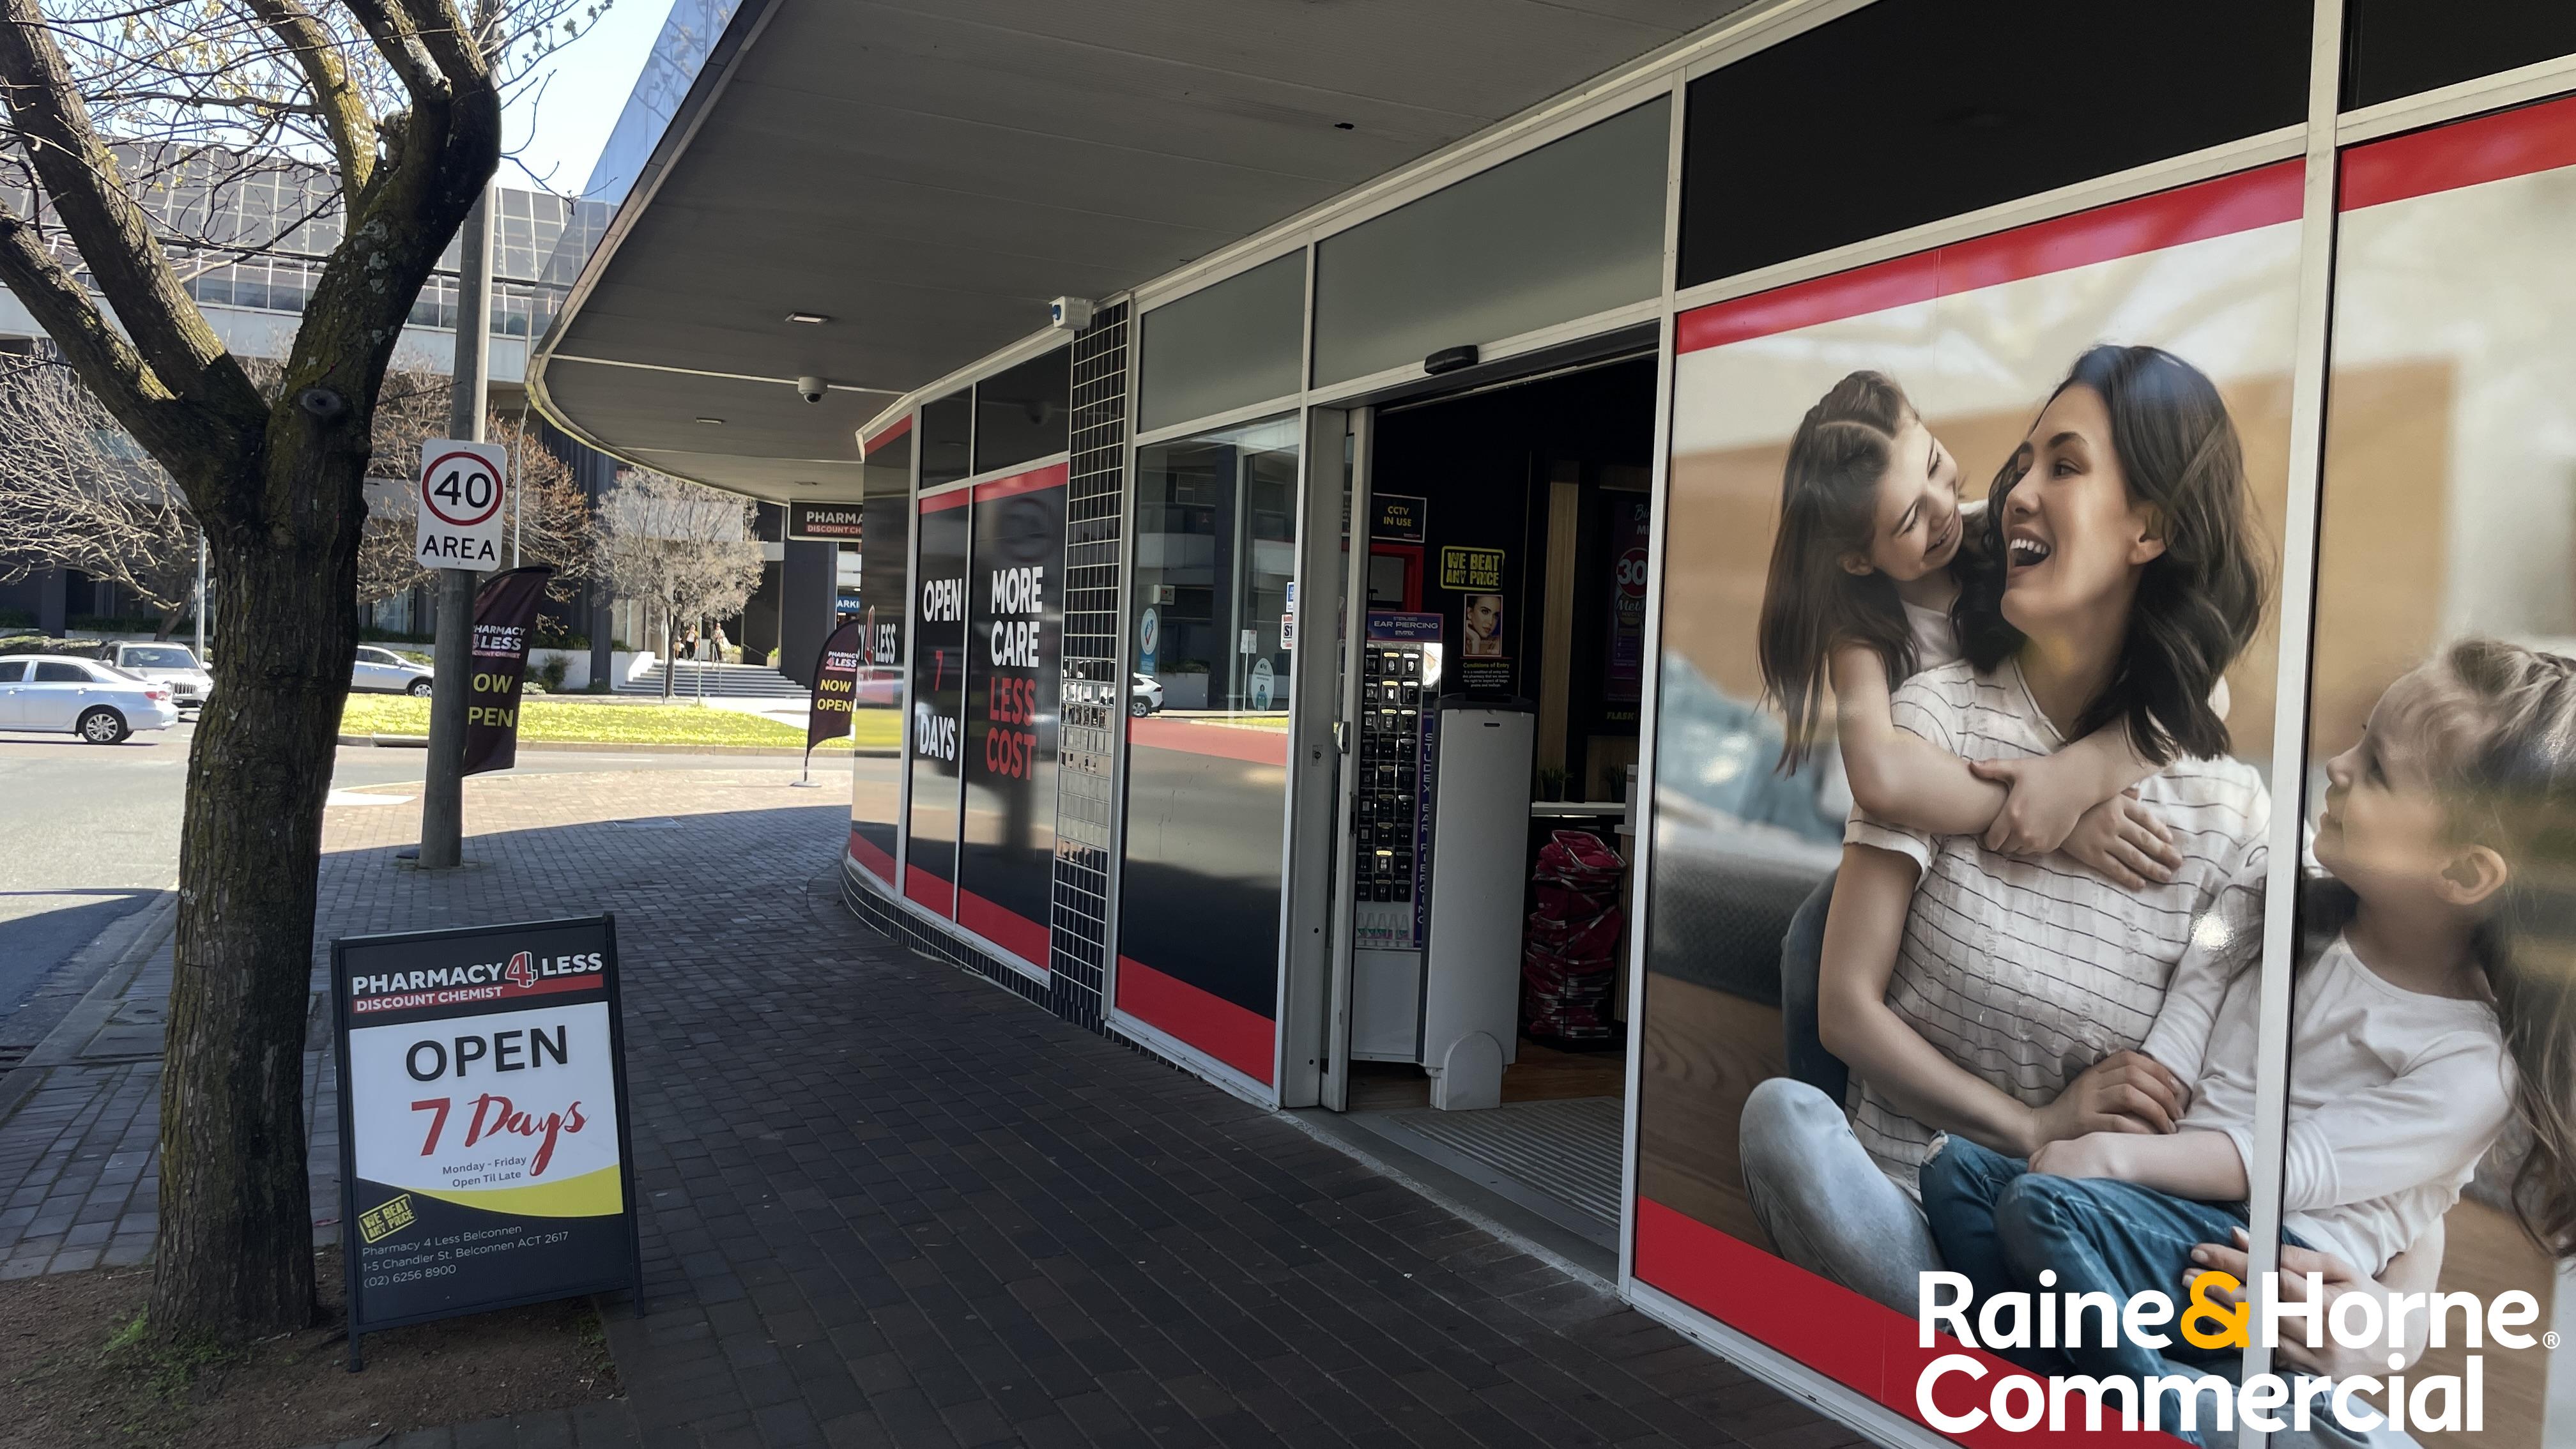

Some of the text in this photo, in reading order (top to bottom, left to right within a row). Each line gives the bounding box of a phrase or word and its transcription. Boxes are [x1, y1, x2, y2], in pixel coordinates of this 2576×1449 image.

[434, 471, 492, 509] 40
[806, 511, 863, 524] PHARMA
[1383, 516, 1411, 526] IN USE
[1388, 505, 1409, 516] CCTV
[808, 525, 848, 533] DISCOUNT
[422, 535, 496, 562] AREA
[1447, 552, 1499, 571] WE BEAT
[1617, 558, 1648, 586] 30
[1446, 569, 1499, 586] ANY PRICE
[924, 579, 962, 622] OPEN
[991, 566, 1043, 615] MORE
[837, 599, 860, 608] ARKI
[473, 625, 526, 636] HARMACY
[480, 636, 521, 650] LESS
[864, 604, 875, 682] 4
[875, 623, 896, 664] LESS
[828, 651, 859, 659] PHARMACY
[991, 620, 1039, 668] CARE
[835, 657, 857, 668] LESS
[935, 650, 944, 691] 7
[473, 673, 512, 694] OW
[820, 679, 852, 693] NOW
[816, 698, 852, 712] OPEN
[990, 677, 1036, 727] LESS
[468, 707, 514, 727] PEN
[919, 714, 956, 761] DAYS
[986, 726, 1036, 780] COST
[352, 951, 602, 995] PHARMACY 4 LESS
[356, 986, 503, 1011] DISCOUNT CHEMIST
[406, 1025, 567, 1081] OPEN
[411, 1093, 590, 1176] 7 Days
[442, 1162, 486, 1175] Monday
[494, 1156, 527, 1167] Friday
[452, 1171, 521, 1188] Open Til Late
[363, 1199, 408, 1228] WE BEAT
[368, 1209, 414, 1238] ANY PRICE
[363, 1225, 522, 1257] Pharmacy 4 Less Belconnen
[364, 1261, 379, 1272] 1-5
[383, 1254, 434, 1269] Chandler
[456, 1241, 514, 1258] Belconnen
[518, 1235, 542, 1248] ACT
[545, 1231, 569, 1244] 2617
[364, 1264, 457, 1288] (02) 6256 8900
